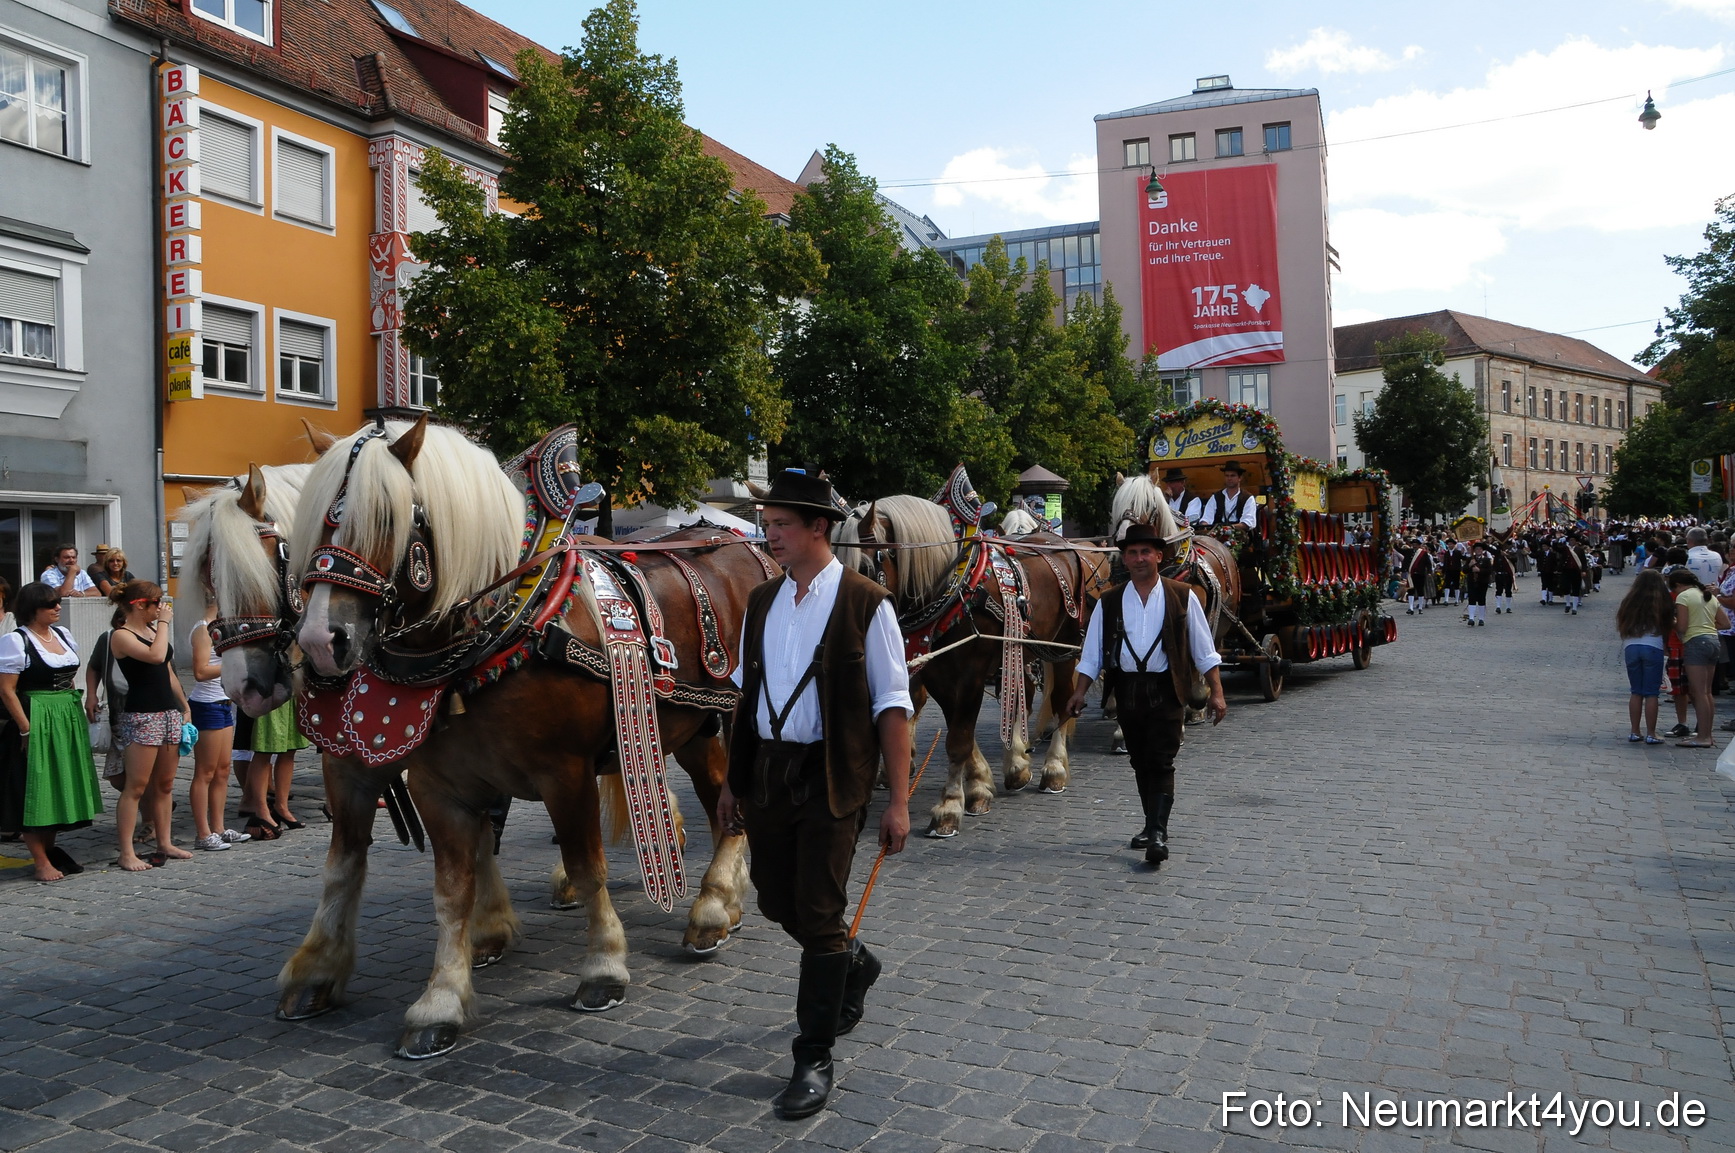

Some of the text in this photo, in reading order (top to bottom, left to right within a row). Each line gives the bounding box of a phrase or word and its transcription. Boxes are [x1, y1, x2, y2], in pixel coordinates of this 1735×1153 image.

[167, 69, 186, 329] BÄCKEREI
[1149, 218, 1198, 235] Danke
[1149, 238, 1231, 252] für Ihr Vertrauen
[1149, 252, 1224, 265] und Ihre Treue.
[1192, 284, 1239, 305] 175
[1193, 304, 1239, 318] JAHRE
[1193, 322, 1220, 330] Sparkasse
[169, 341, 190, 360] café
[169, 376, 191, 396] plank
[1175, 422, 1235, 457] Glossner
[1207, 440, 1236, 453] Bier
